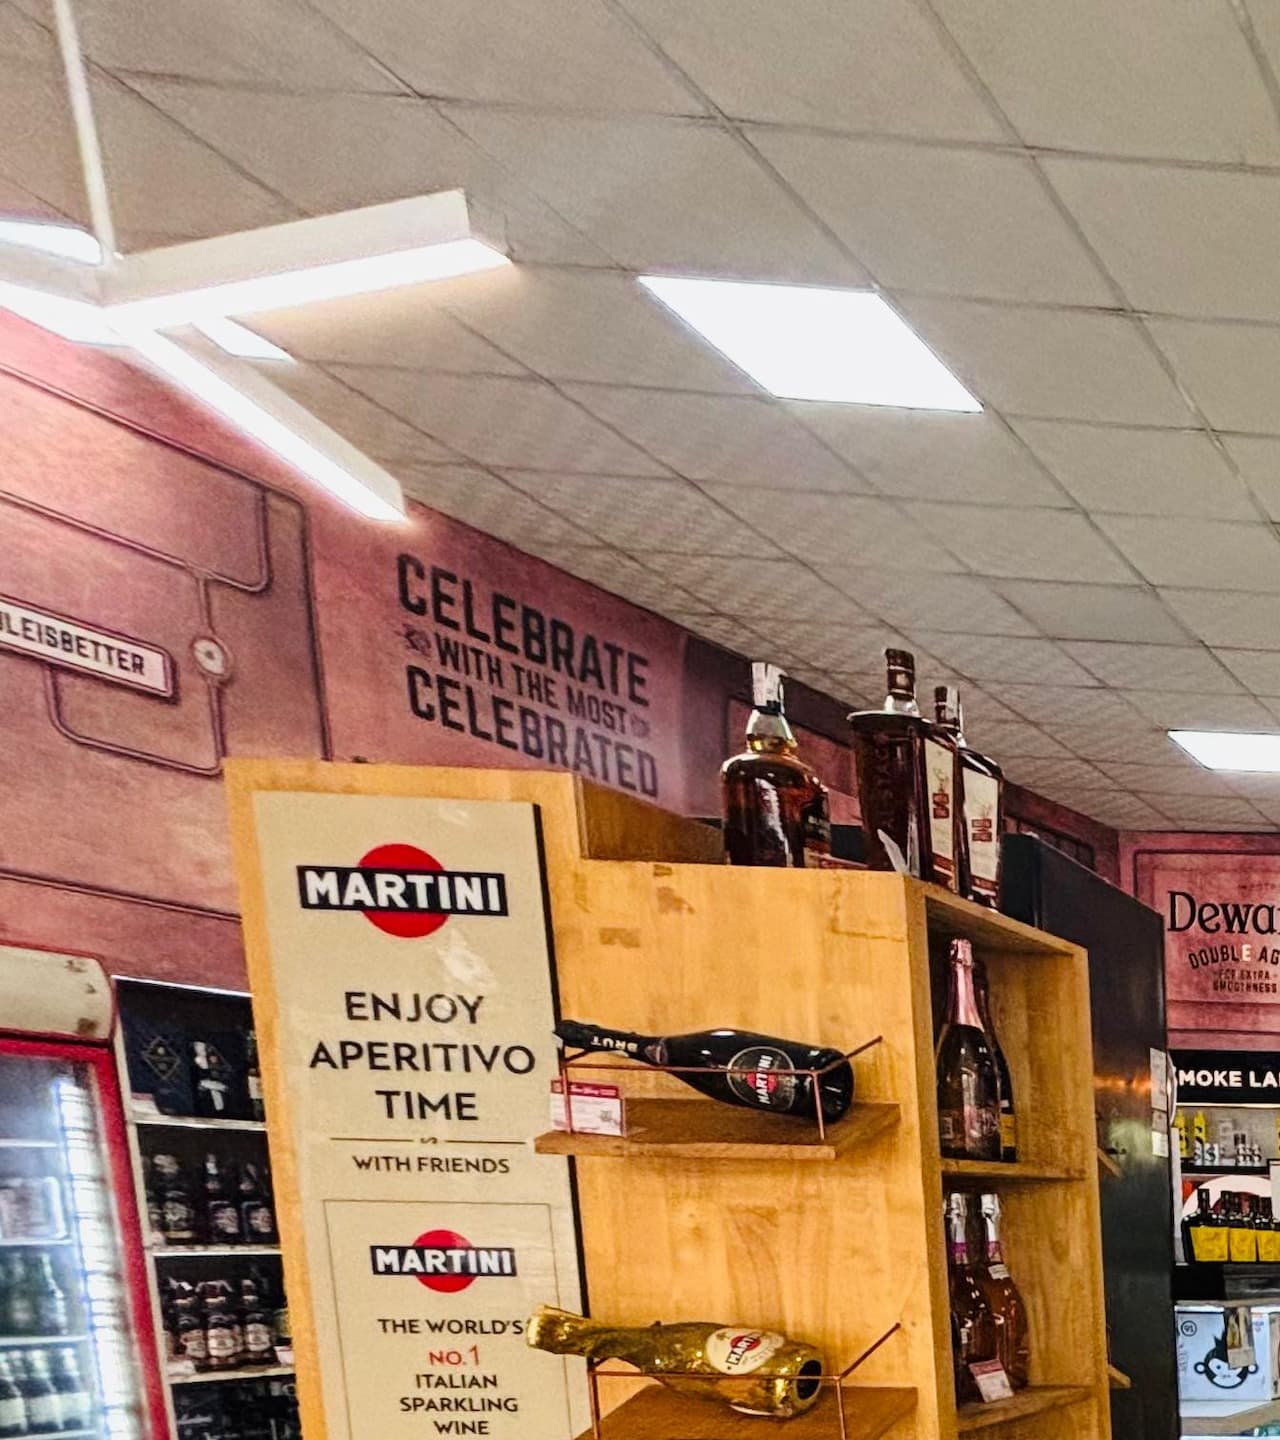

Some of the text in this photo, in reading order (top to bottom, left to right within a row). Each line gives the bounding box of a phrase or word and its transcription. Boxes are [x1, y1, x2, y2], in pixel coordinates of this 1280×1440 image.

[0, 612, 145, 675] LEISBETTER
[398, 554, 649, 707] CELEBRATE
[435, 632, 627, 734] WITH THE MOST
[406, 665, 658, 798] CELEBRATED
[304, 870, 501, 911] MARTINI
[1188, 944, 1251, 970] DOUBLE
[345, 991, 484, 1024] ENJOY
[309, 1041, 536, 1075] APERITIVO
[375, 1090, 479, 1121] TIME
[352, 1155, 511, 1174] WITH FRIENDS
[375, 1248, 514, 1275] MARTINI
[377, 1318, 524, 1335] THE WORLD'S
[416, 1374, 497, 1388] ITALIAN
[400, 1398, 519, 1412] SPARKLING
[434, 1421, 489, 1434] WINE
